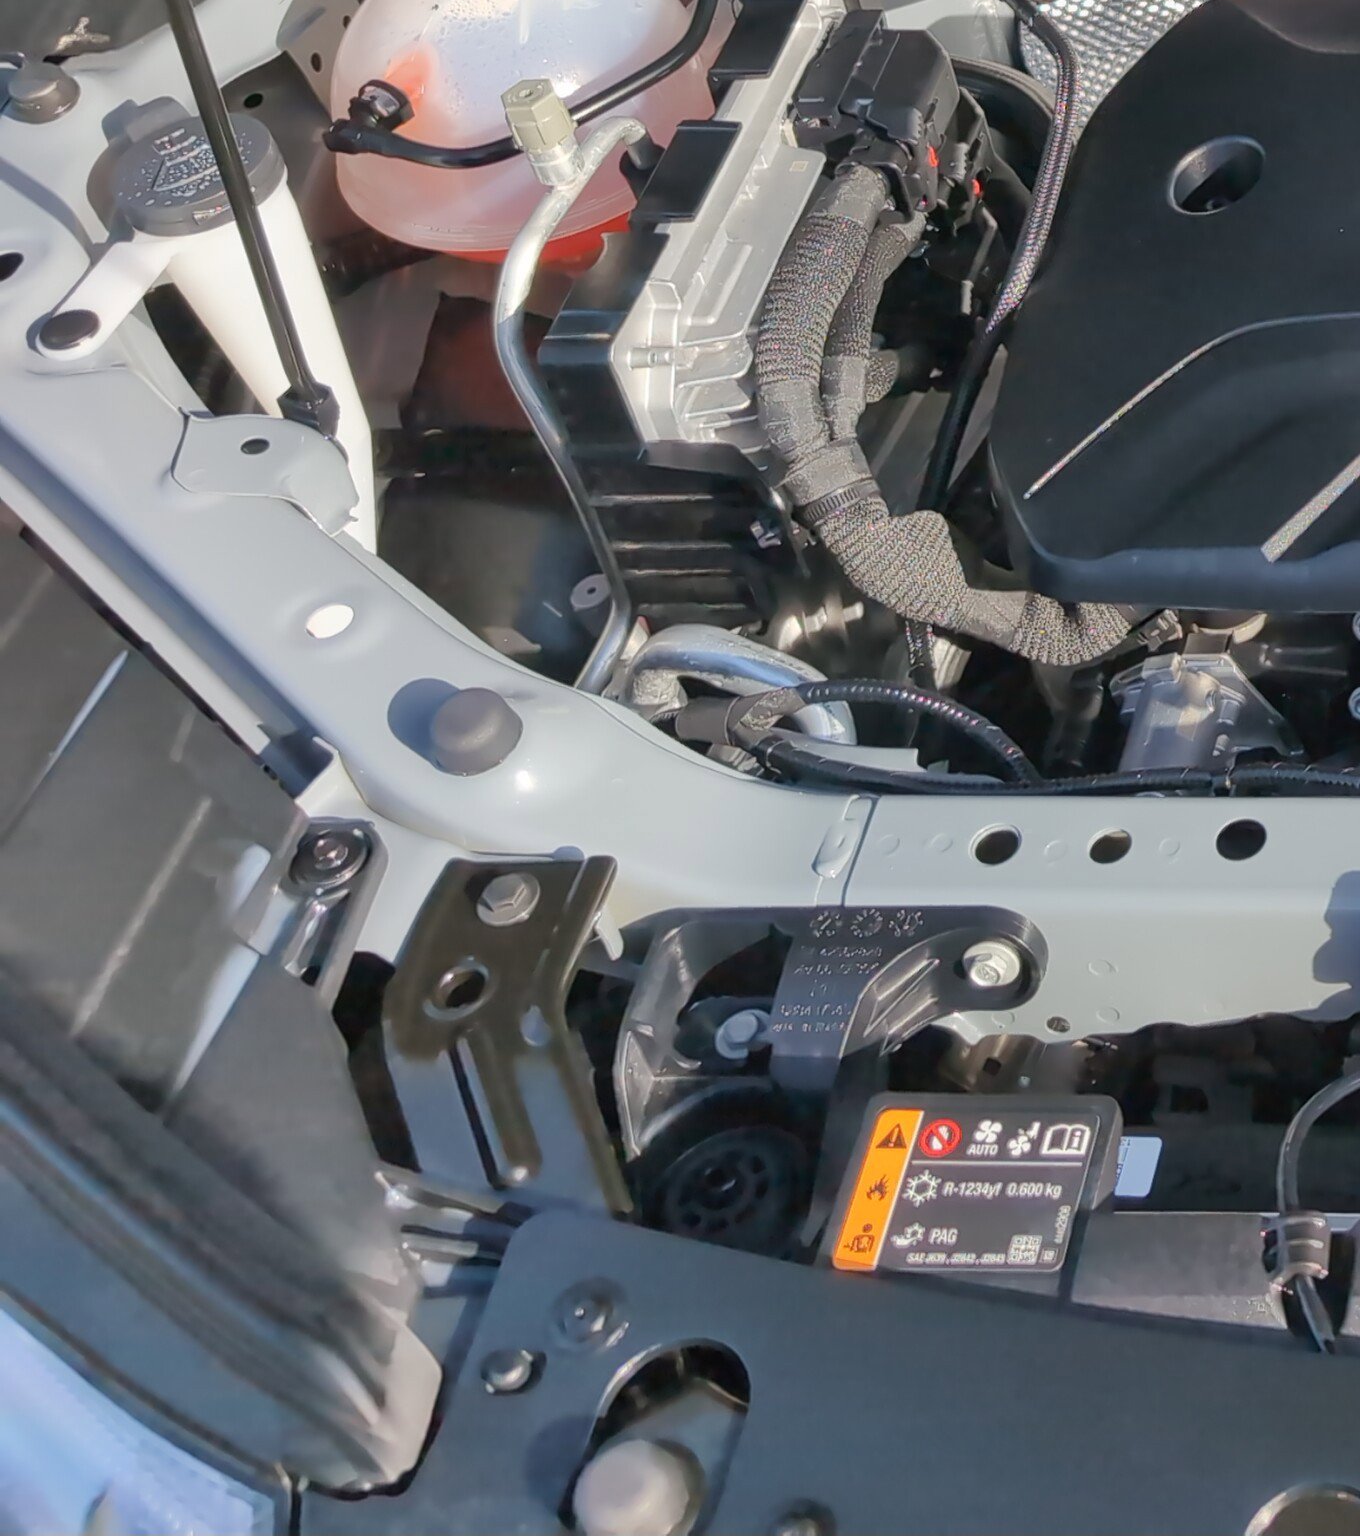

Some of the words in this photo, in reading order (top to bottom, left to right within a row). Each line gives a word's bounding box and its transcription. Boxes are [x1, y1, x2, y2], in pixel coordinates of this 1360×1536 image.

[966, 1144, 998, 1156] AUTO
[942, 1181, 1003, 1200] R-1234yf
[1005, 1181, 1042, 1197] 0.600
[1044, 1182, 1063, 1200] kg
[928, 1227, 959, 1244] PAG
